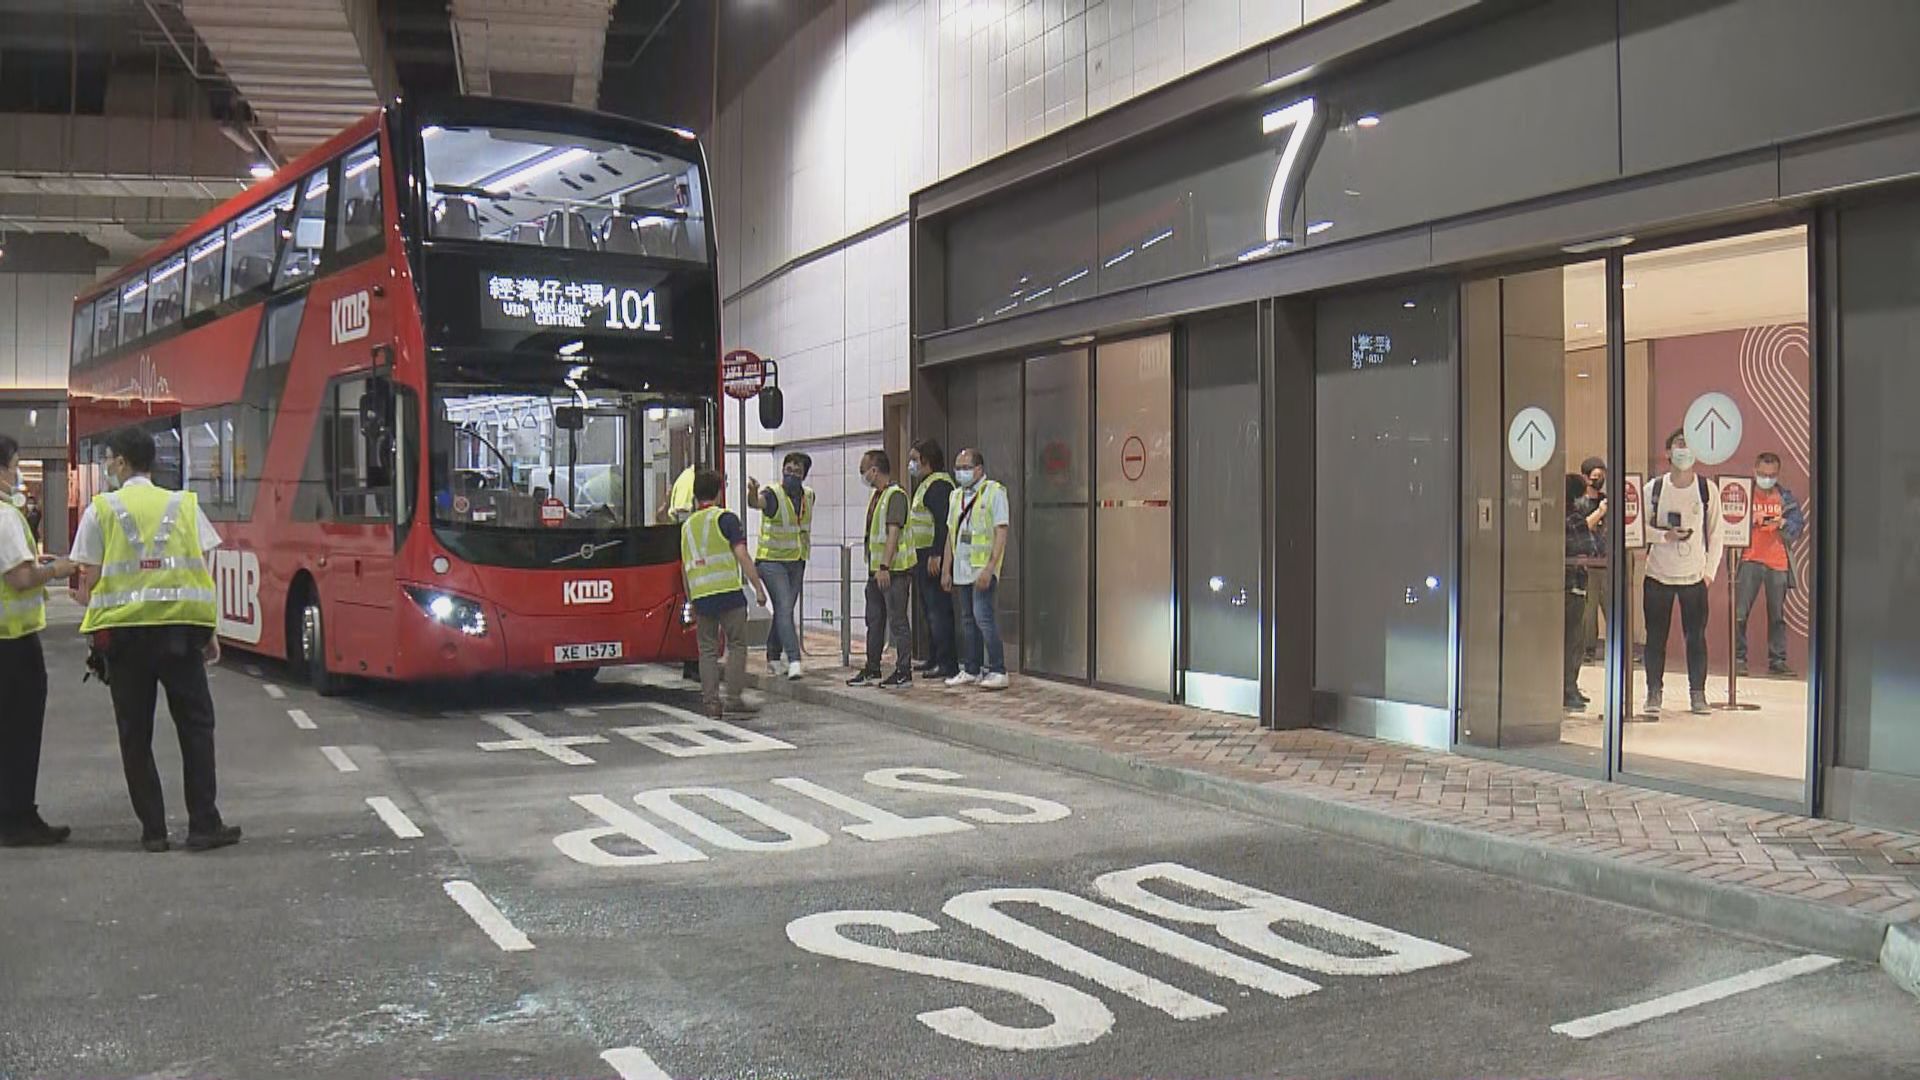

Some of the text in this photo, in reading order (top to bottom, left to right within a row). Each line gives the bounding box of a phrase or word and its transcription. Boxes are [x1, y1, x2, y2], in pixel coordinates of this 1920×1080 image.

[1262, 97, 1315, 242] 7
[489, 276, 604, 307] 經灣仔中環
[532, 299, 554, 313] WAN
[603, 287, 661, 332] 101
[331, 290, 370, 346] KMB
[535, 313, 586, 328] CENTRAL
[207, 549, 262, 643] MB
[563, 580, 614, 605] KMB
[562, 644, 617, 660] XE 1573
[553, 767, 1072, 866] STOP
[786, 862, 1472, 1051] BUS
